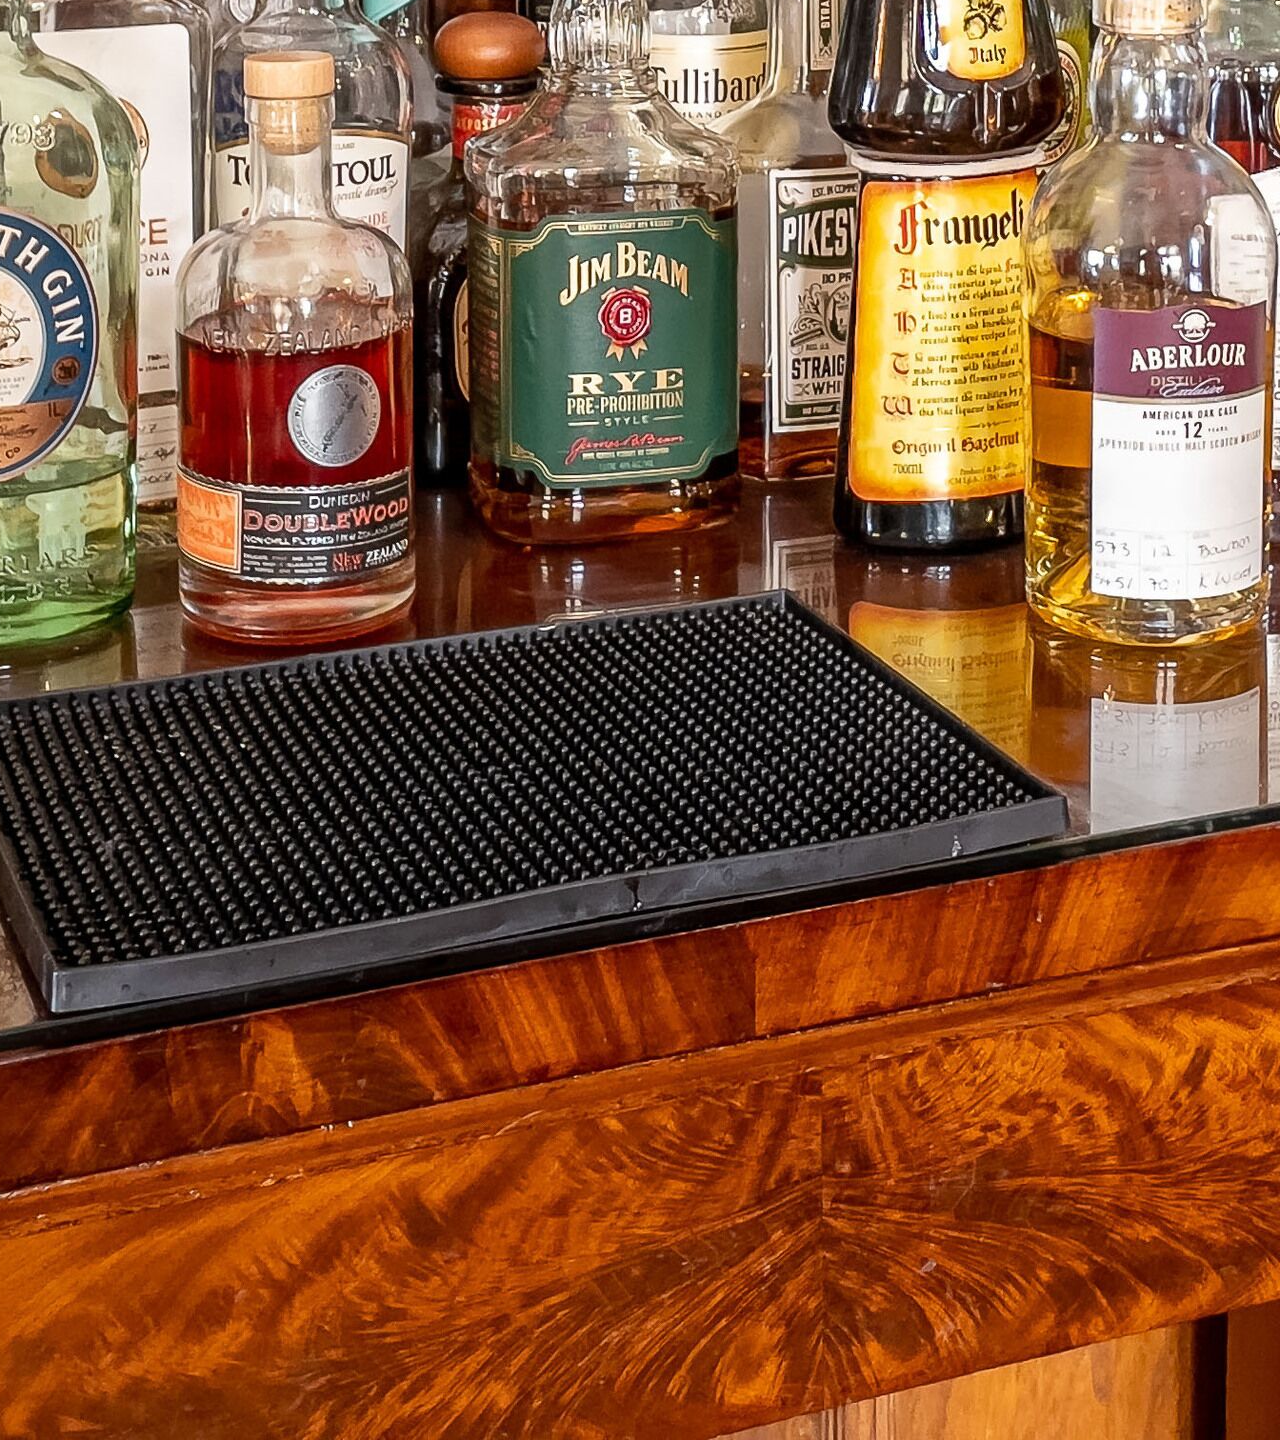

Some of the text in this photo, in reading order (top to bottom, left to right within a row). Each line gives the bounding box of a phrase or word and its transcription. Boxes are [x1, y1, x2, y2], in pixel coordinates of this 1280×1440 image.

[969, 44, 1007, 65] Italy
[652, 62, 767, 104] Tullibard
[782, 208, 857, 256] PIKES
[894, 187, 1024, 256] Frangeli
[559, 241, 689, 306] JIM BEAM
[42, 269, 85, 344] GIN
[620, 309, 632, 324] B
[264, 325, 362, 357] ZEALAND
[791, 353, 845, 380] STRAIG
[1130, 343, 1246, 373] ABERLOUR
[568, 368, 684, 396] RYE
[567, 390, 684, 415] PRE-PROHIBITION
[1142, 406, 1238, 420] AMERICAN OAK CASK
[602, 415, 649, 427] STYLE
[1184, 422, 1202, 439] 12
[962, 432, 1019, 452] Hazelnut
[1185, 441, 1206, 451] MALT
[1210, 437, 1238, 449] SCOTCH
[243, 496, 408, 533] DOUBLEWOOD
[366, 538, 409, 562] ZEALAND
